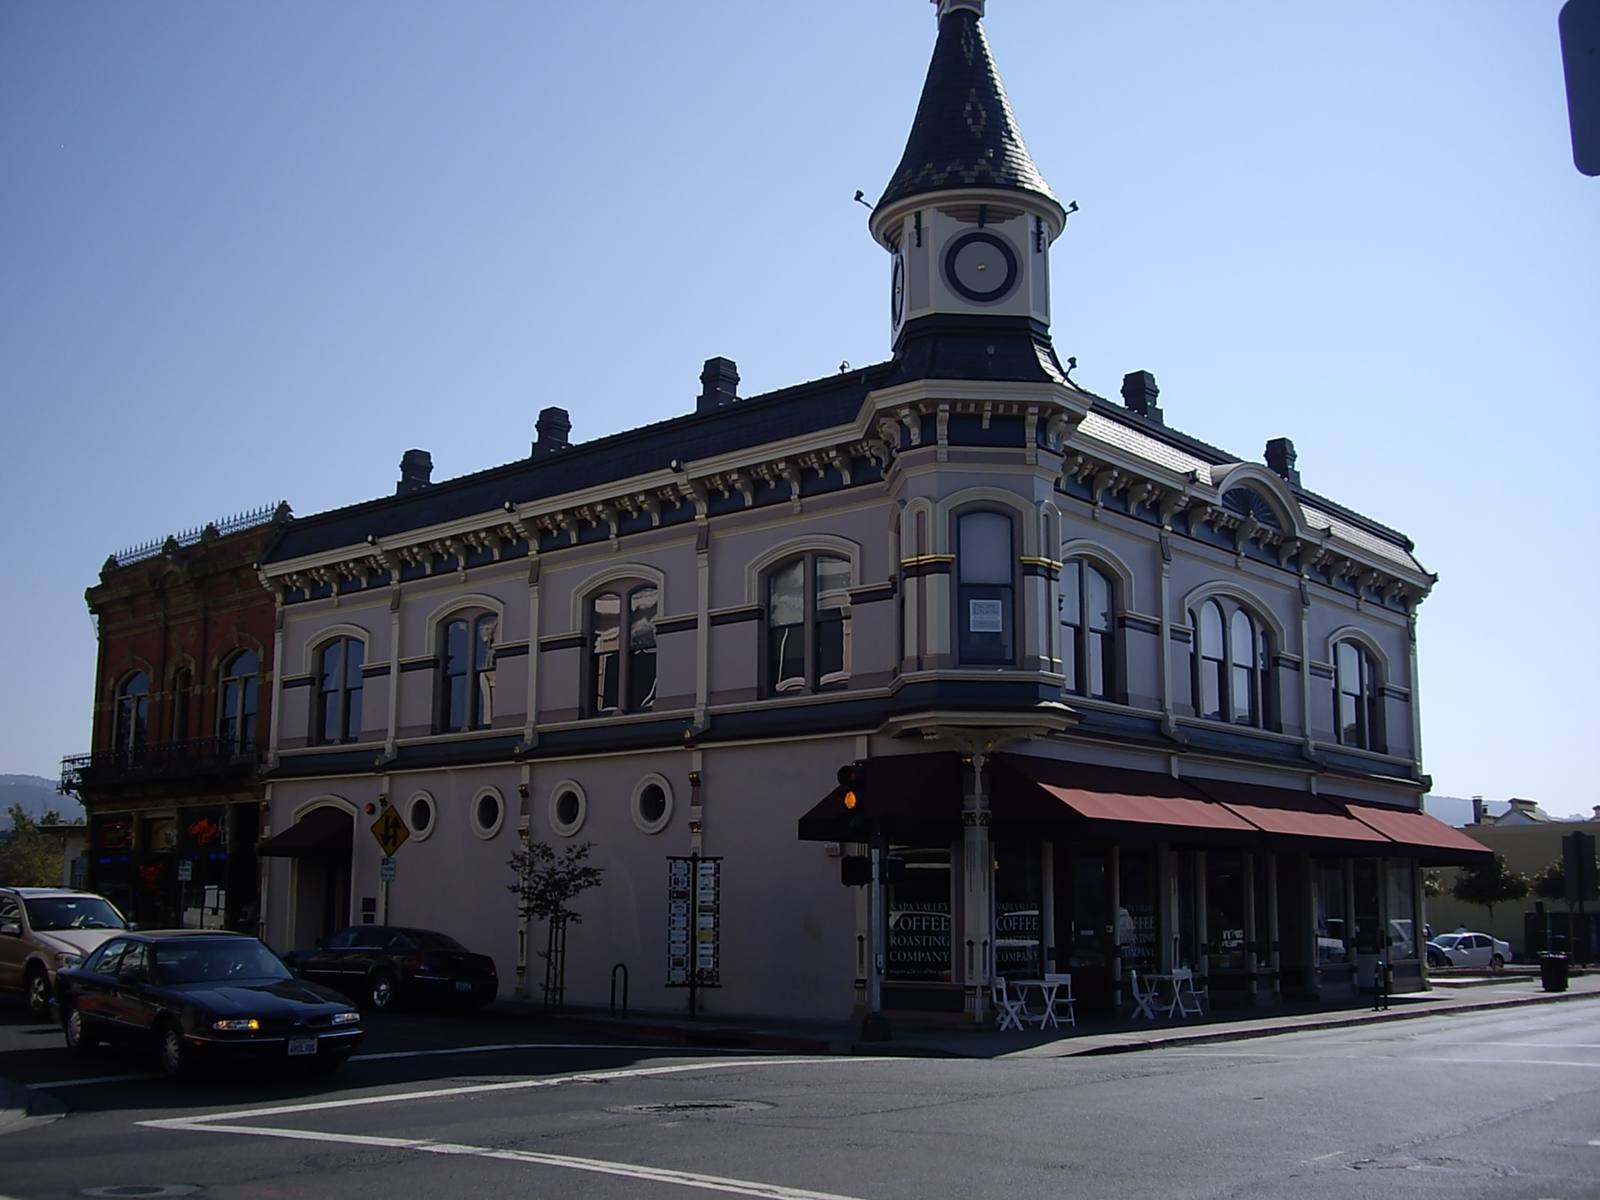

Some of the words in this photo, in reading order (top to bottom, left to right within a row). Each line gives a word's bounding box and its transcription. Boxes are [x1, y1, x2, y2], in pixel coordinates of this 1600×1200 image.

[995, 915, 1039, 931] COFFEE
[890, 935, 950, 947] ROASTING
[889, 951, 949, 962] COMPANY
